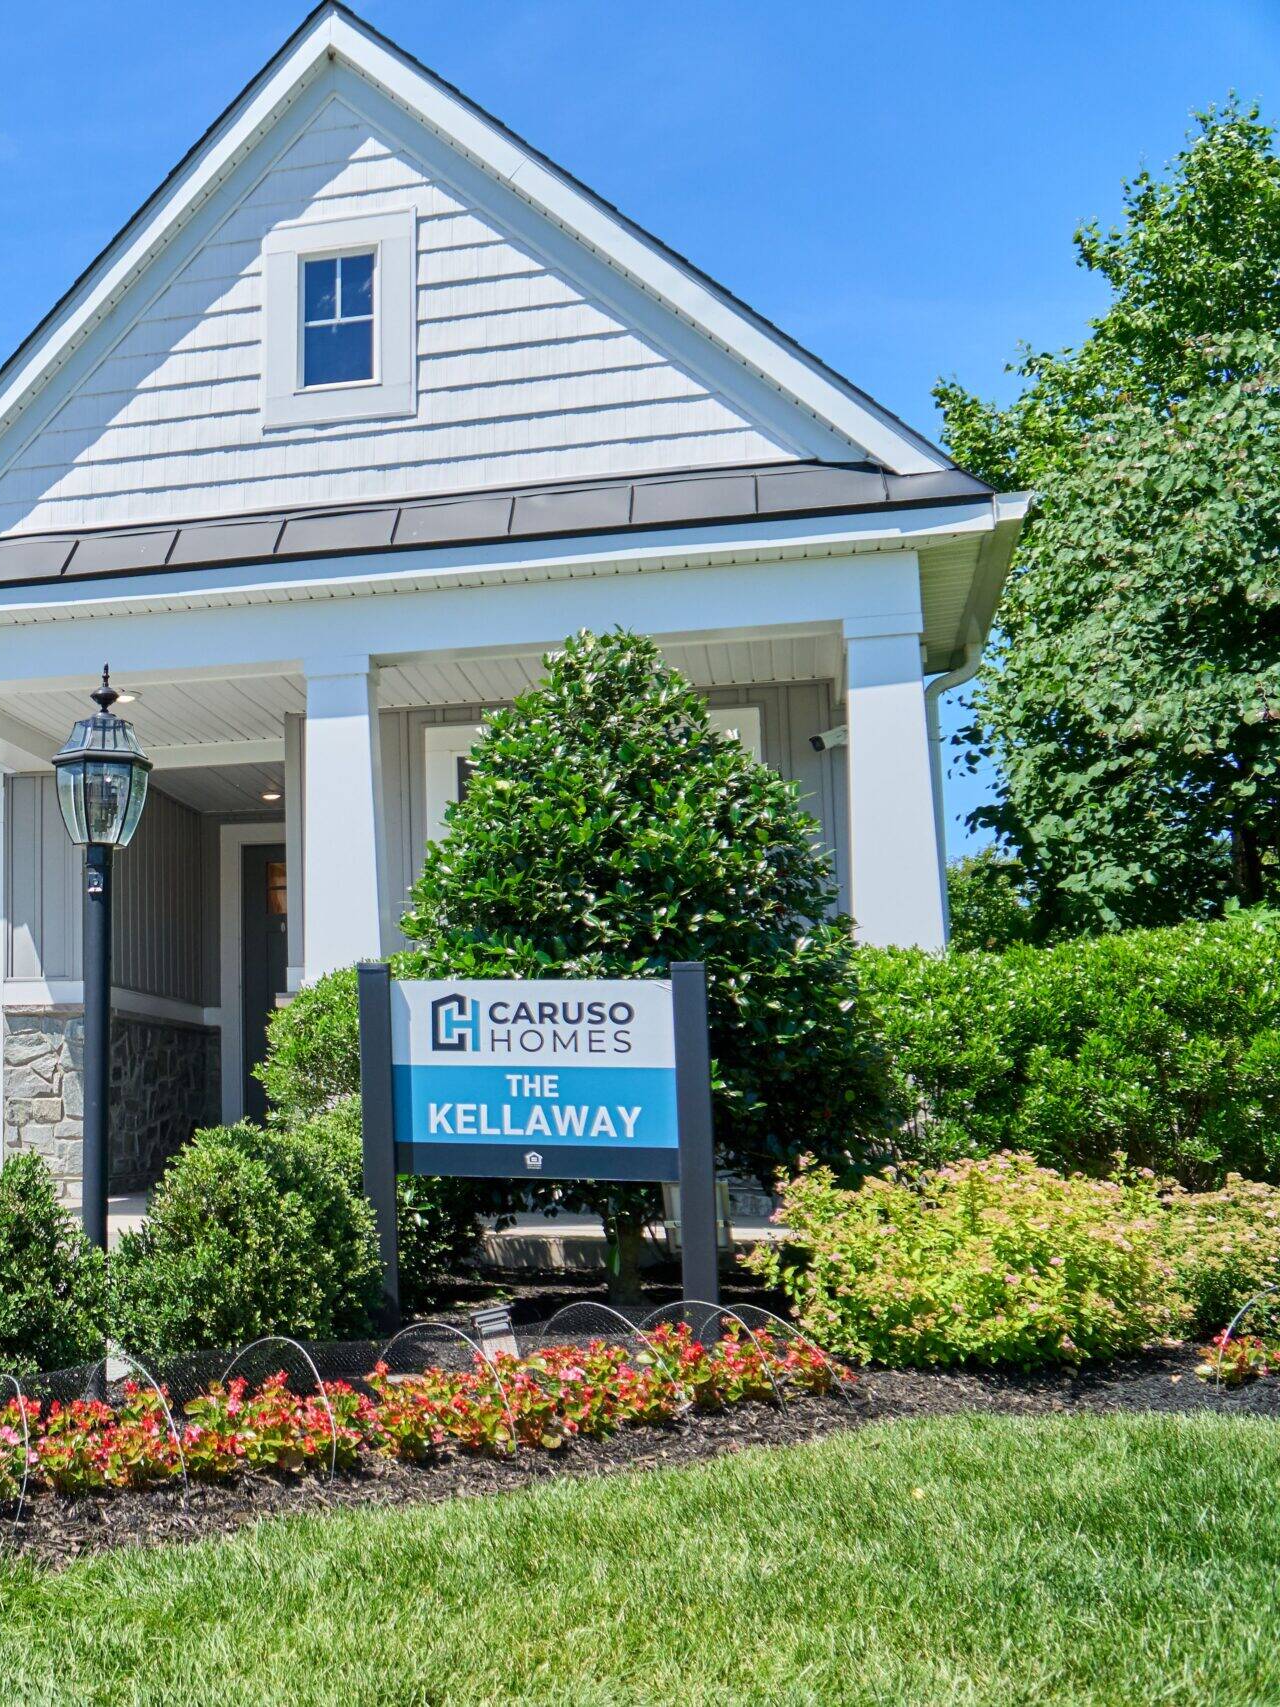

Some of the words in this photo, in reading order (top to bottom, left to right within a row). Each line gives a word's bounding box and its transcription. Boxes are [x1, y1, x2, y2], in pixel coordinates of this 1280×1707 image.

[489, 1001, 635, 1025] CARUSO
[491, 1029, 632, 1053] HOMES
[506, 1074, 559, 1097] THE
[428, 1103, 642, 1138] KELLAWAY
